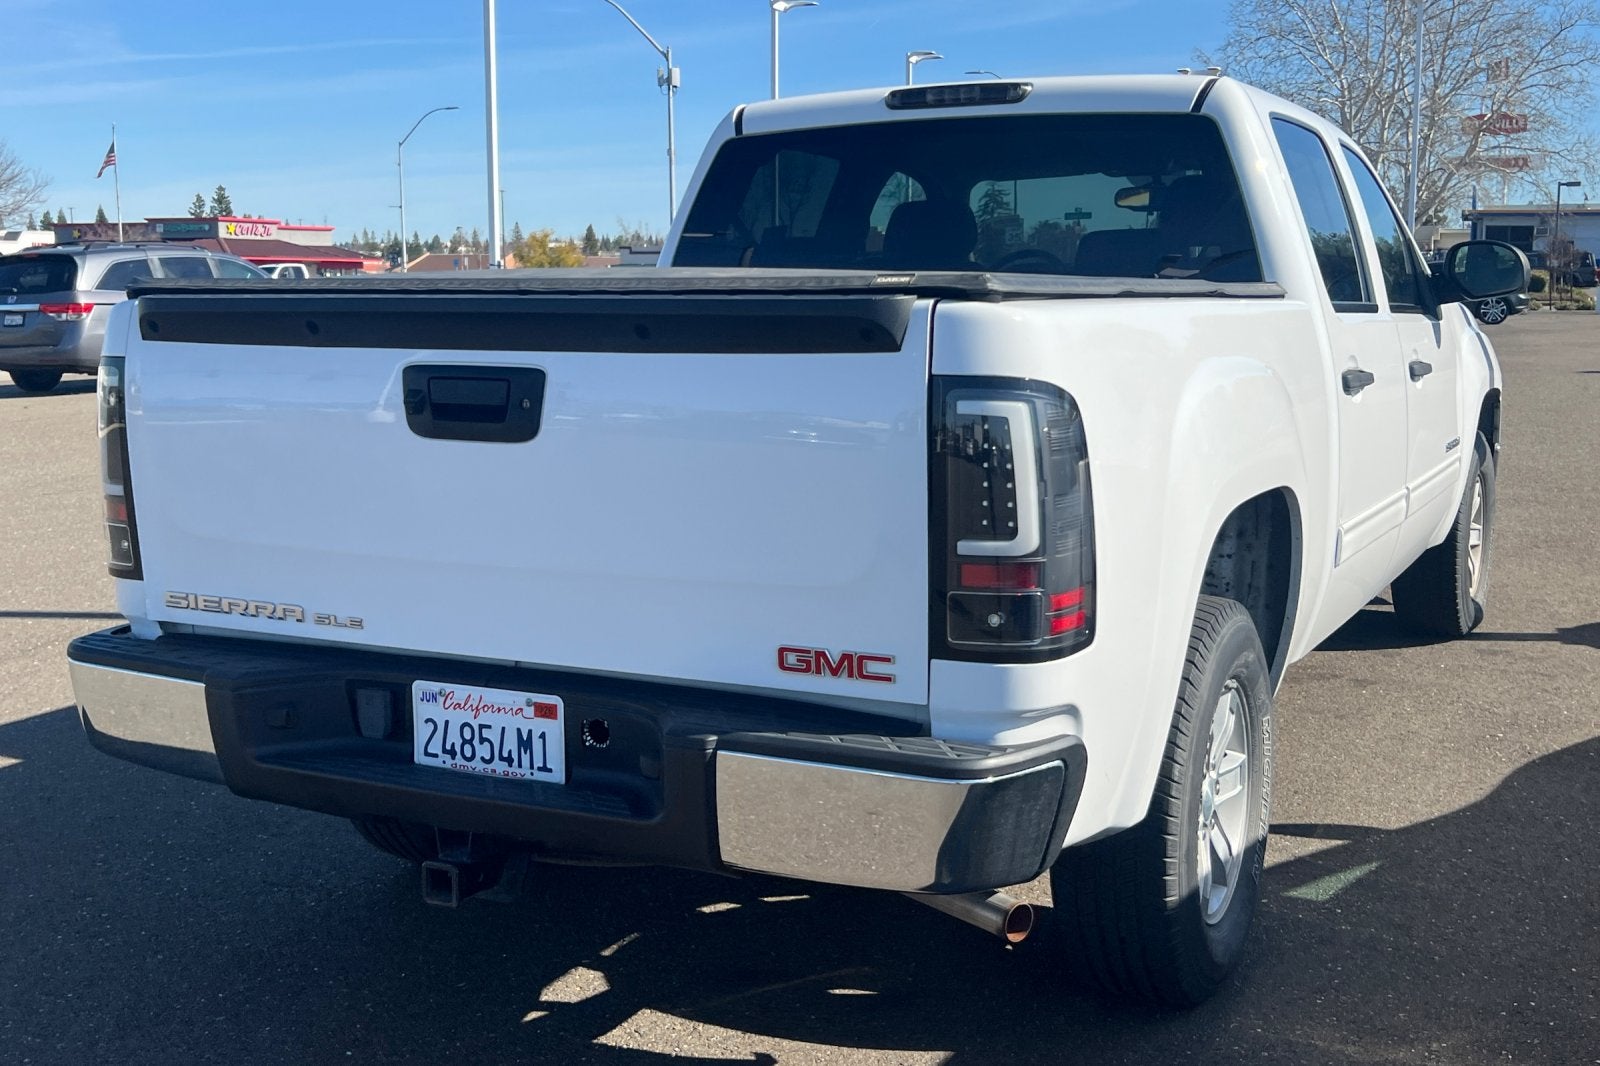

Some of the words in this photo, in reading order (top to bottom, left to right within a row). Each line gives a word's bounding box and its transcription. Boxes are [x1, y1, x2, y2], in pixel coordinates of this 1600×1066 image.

[165, 591, 304, 623] SIERRA
[314, 613, 364, 629] SLE
[777, 645, 896, 684] GMC
[420, 690, 438, 704] JUN
[443, 690, 534, 720] California
[423, 718, 553, 773] 24854M1
[451, 762, 526, 777] dmv.ca.gov
[1253, 716, 1272, 885] MICHELIN
